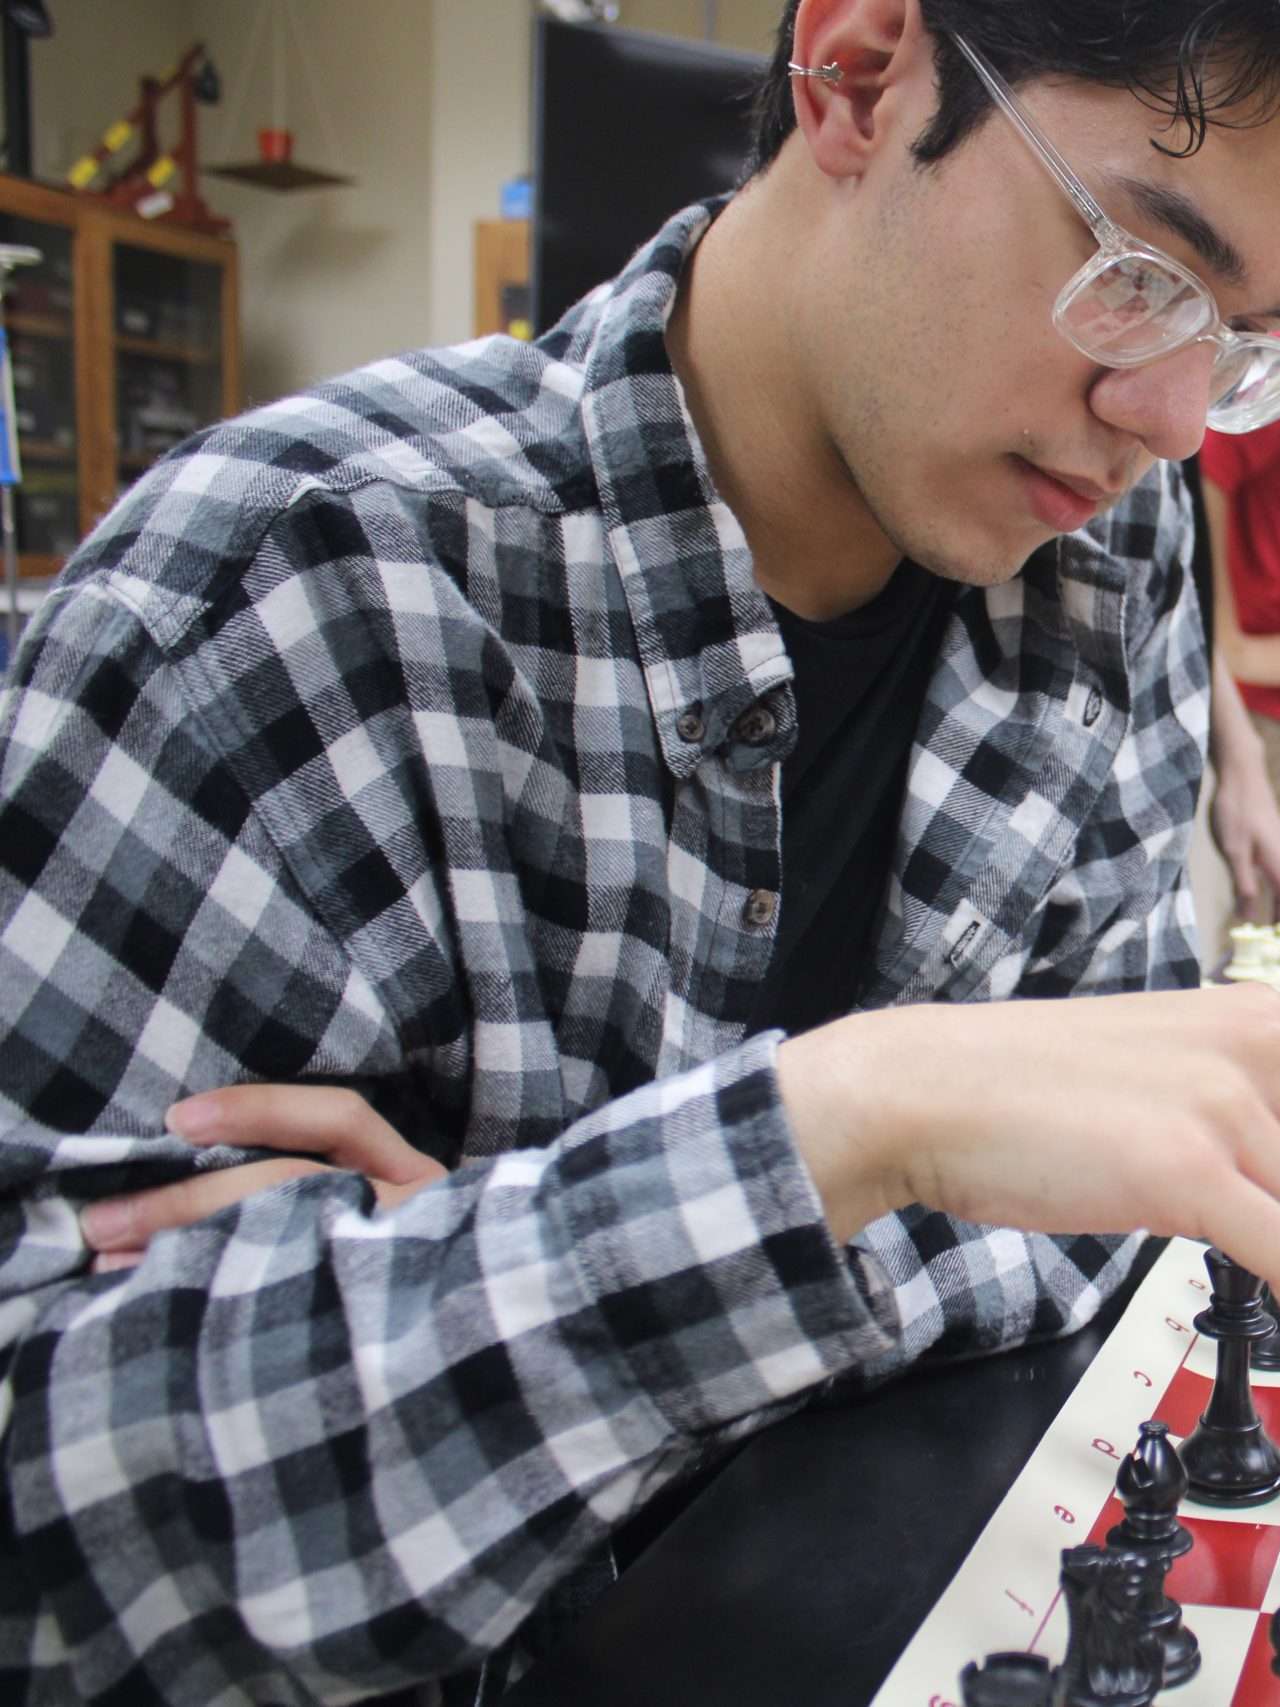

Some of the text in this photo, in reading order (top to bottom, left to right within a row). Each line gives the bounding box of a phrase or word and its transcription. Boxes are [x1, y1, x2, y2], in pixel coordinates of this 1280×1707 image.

[1133, 1370, 1152, 1387] c
[1091, 1438, 1121, 1461] d
[1054, 1504, 1076, 1524] e
